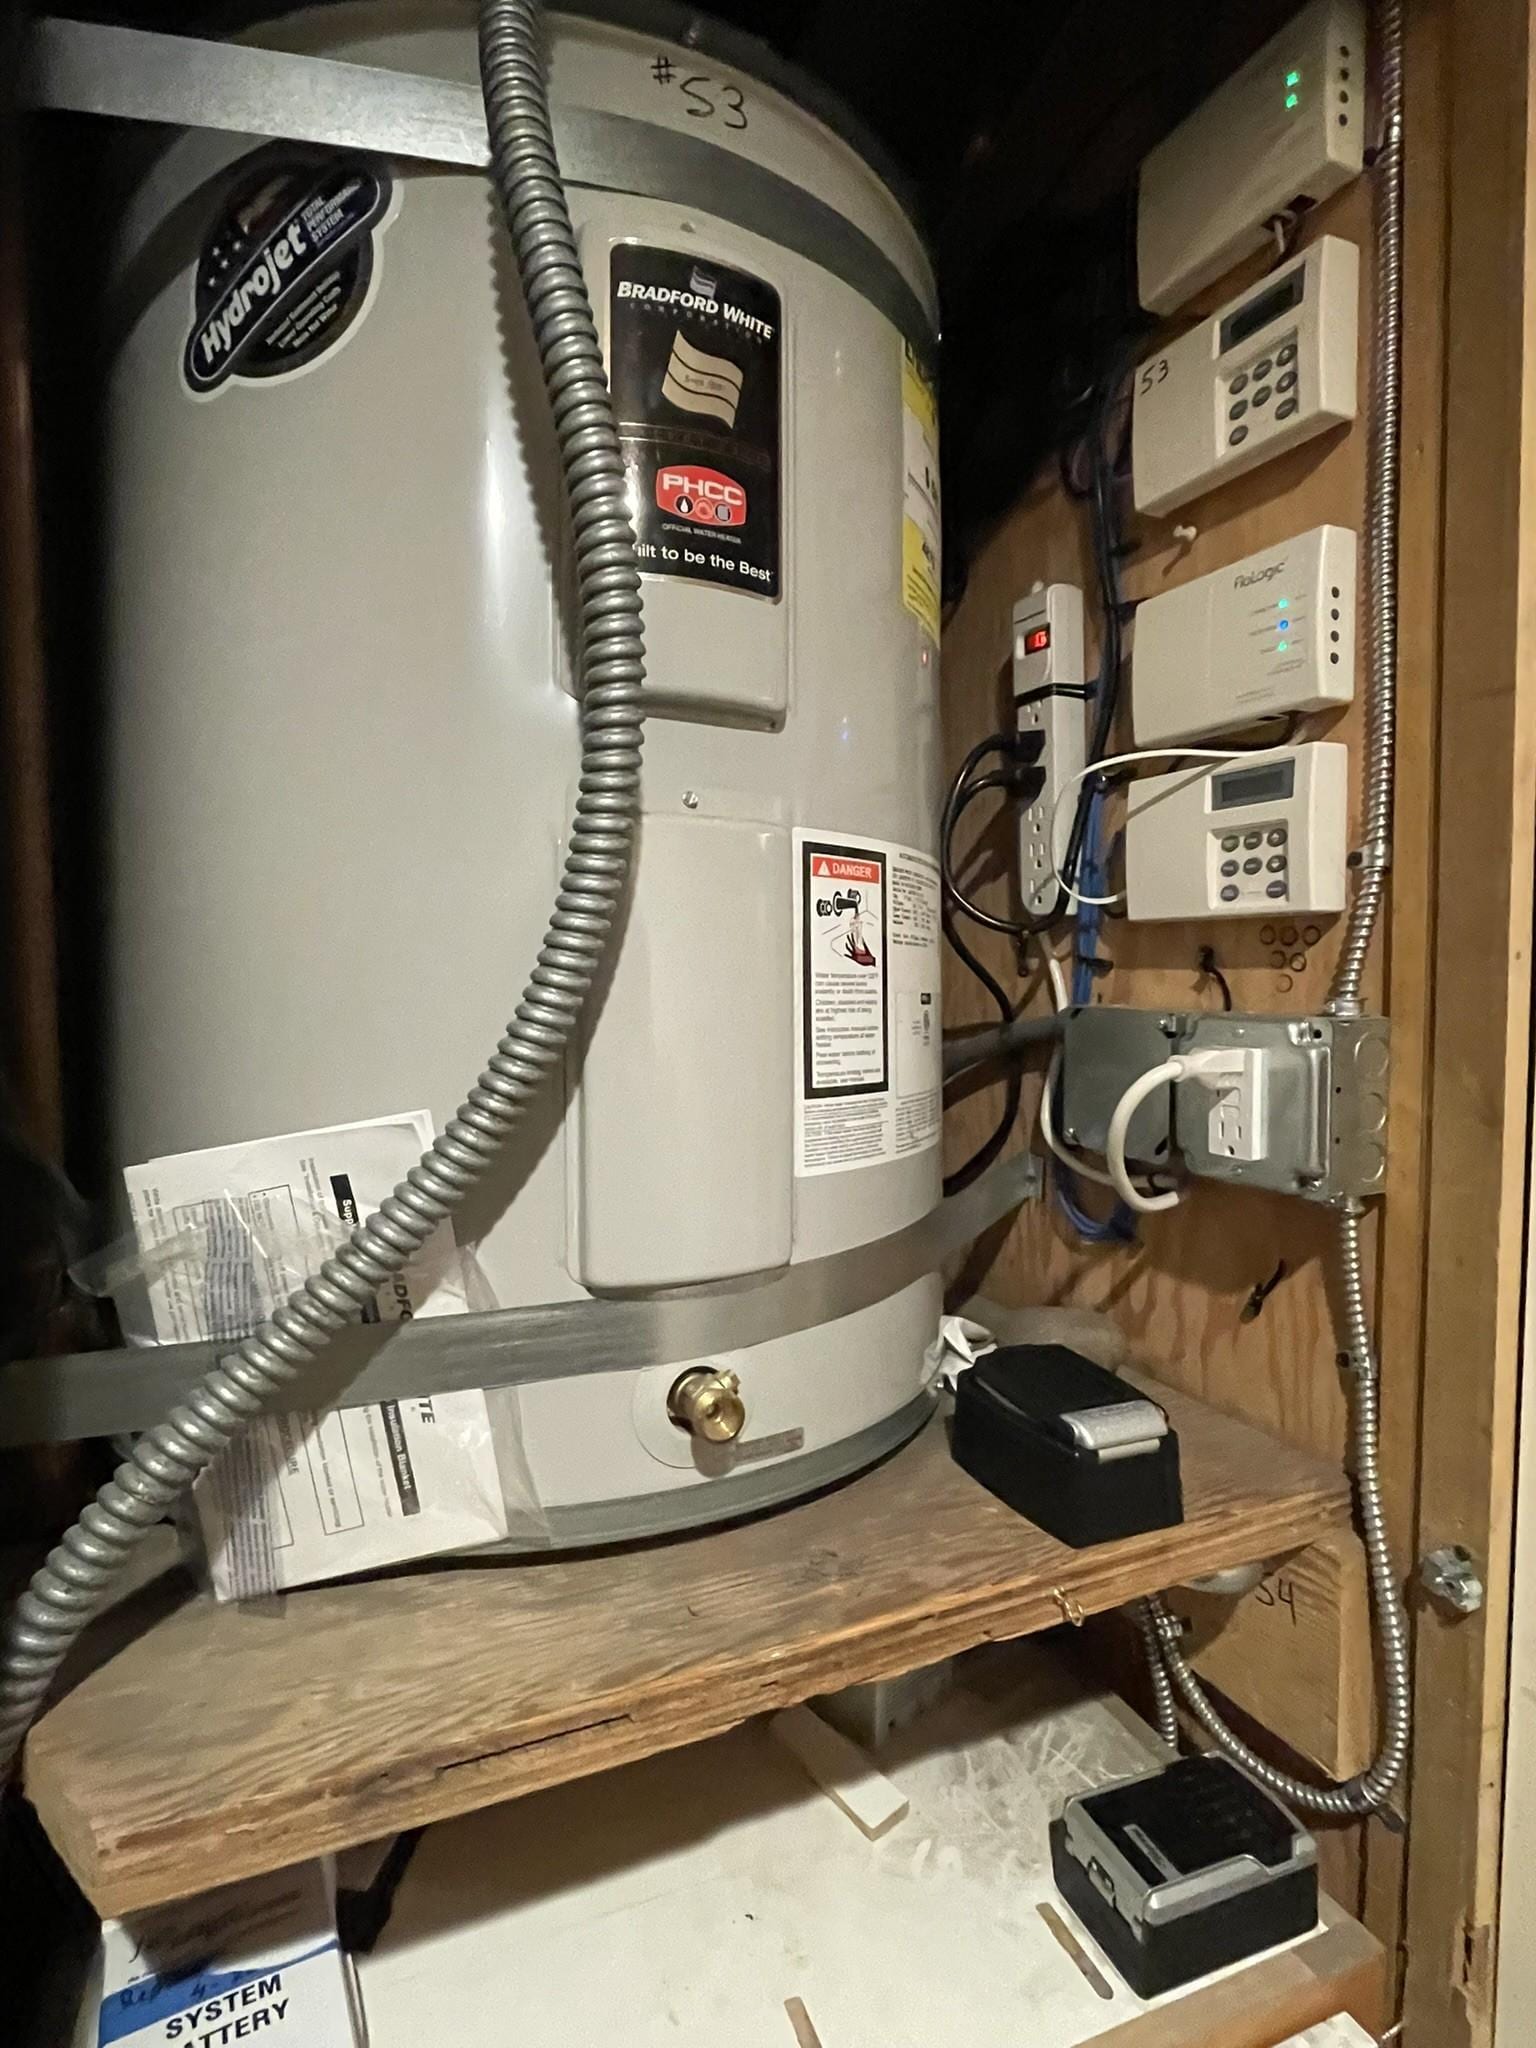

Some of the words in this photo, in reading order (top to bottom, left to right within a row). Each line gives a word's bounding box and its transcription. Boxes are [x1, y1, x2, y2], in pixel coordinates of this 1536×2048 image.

[201, 222, 307, 364] Hydrojet
[617, 281, 719, 314] BRADFORD
[723, 303, 774, 339] WHITE
[662, 473, 743, 506] PHCC
[661, 546, 679, 560] to
[684, 548, 705, 564] be
[710, 554, 735, 571] the
[739, 561, 771, 582] Best
[832, 862, 872, 879] DANGER
[397, 1453, 411, 1490] Blanket
[165, 1973, 283, 2040] SYSTEM
